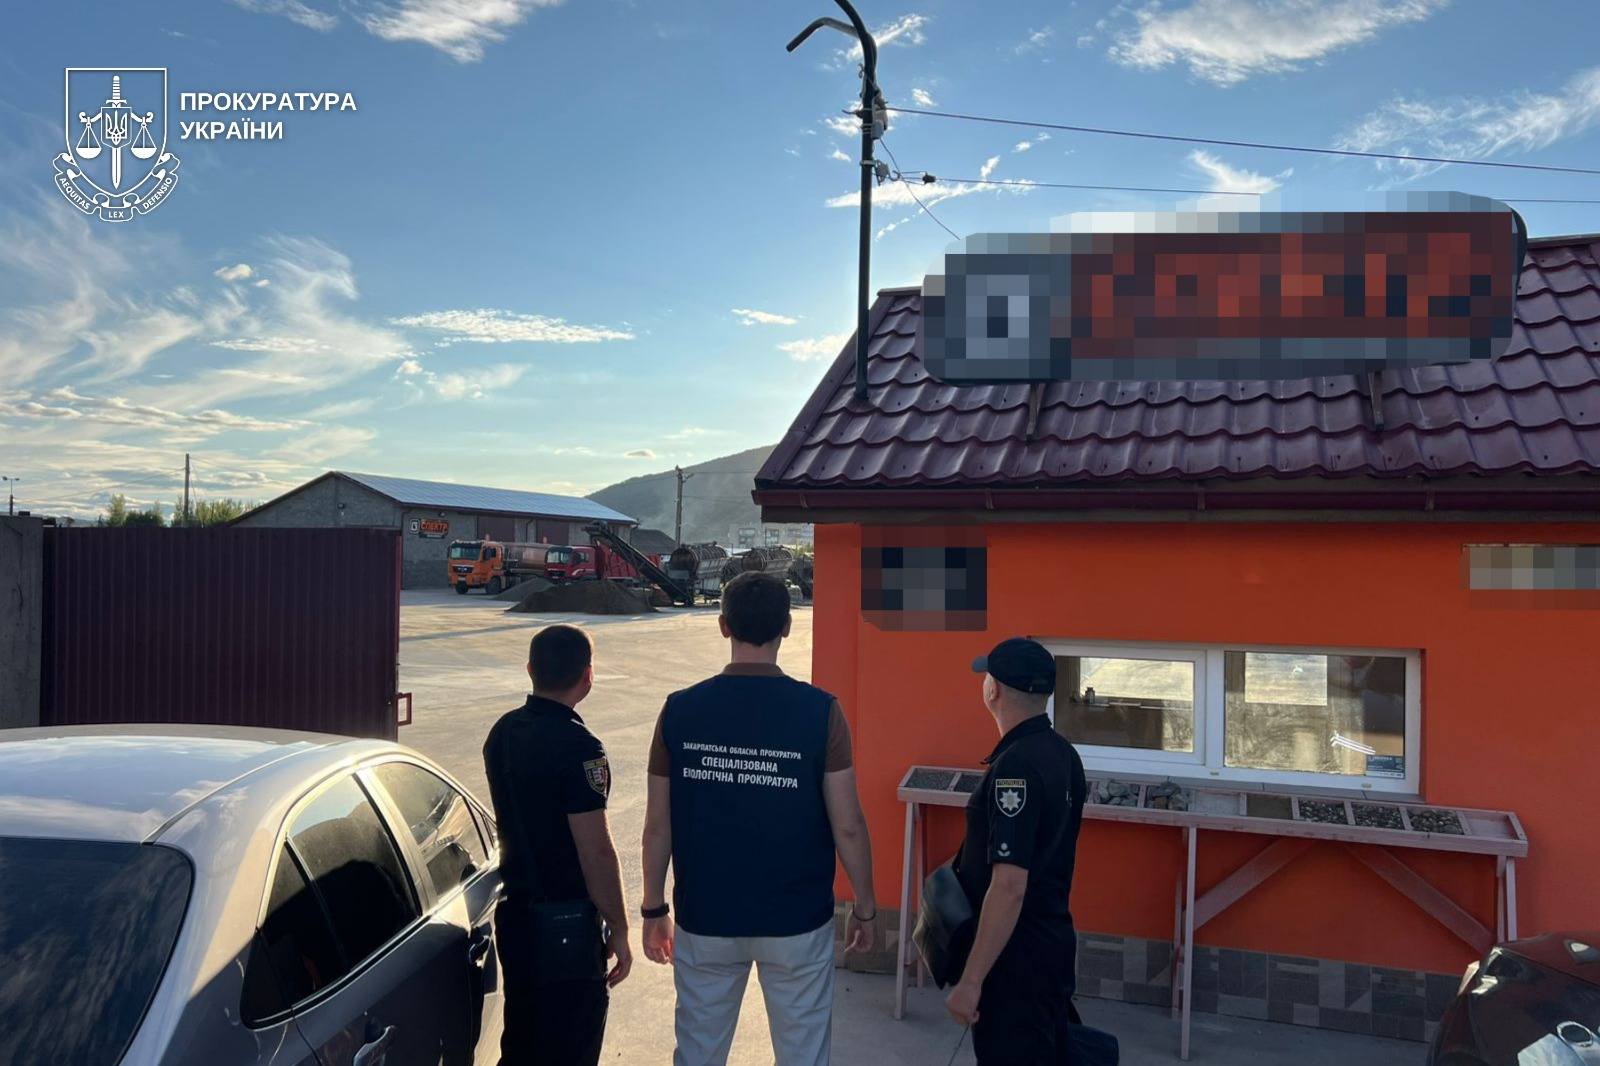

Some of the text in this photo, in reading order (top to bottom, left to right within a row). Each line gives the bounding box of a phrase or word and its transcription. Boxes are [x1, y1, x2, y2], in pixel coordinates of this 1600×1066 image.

[683, 742, 727, 753] ЗАКАРПАТСЬКА
[760, 749, 802, 760] ПРОКУРАТУРА
[701, 756, 778, 773] СПЕЦІАЛІЗОВАНА
[737, 773, 798, 789] ПРОКУРАТУРА
